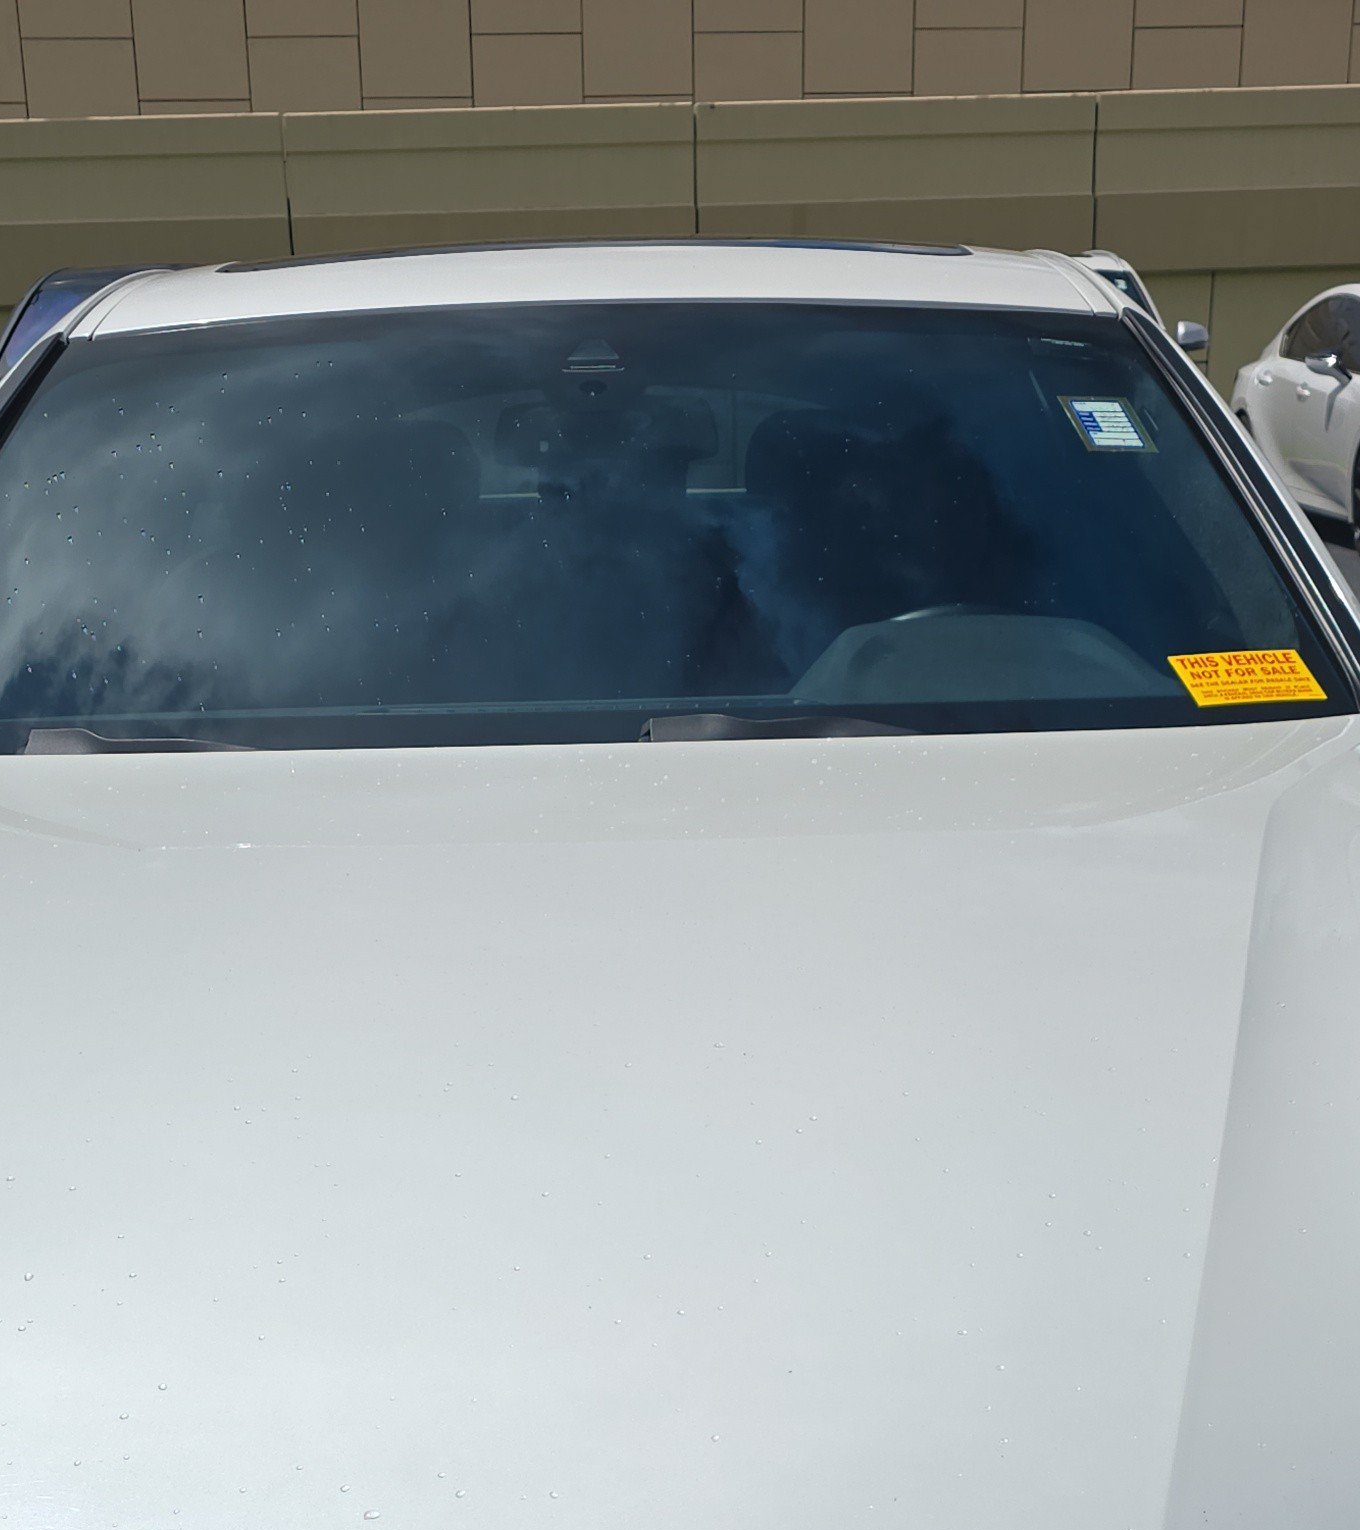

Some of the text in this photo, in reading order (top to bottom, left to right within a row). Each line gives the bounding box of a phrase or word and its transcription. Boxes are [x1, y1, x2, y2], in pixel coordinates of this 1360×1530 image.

[1176, 652, 1297, 670] THIS VEHICLE
[1190, 665, 1301, 680] NOT FOR SALE
